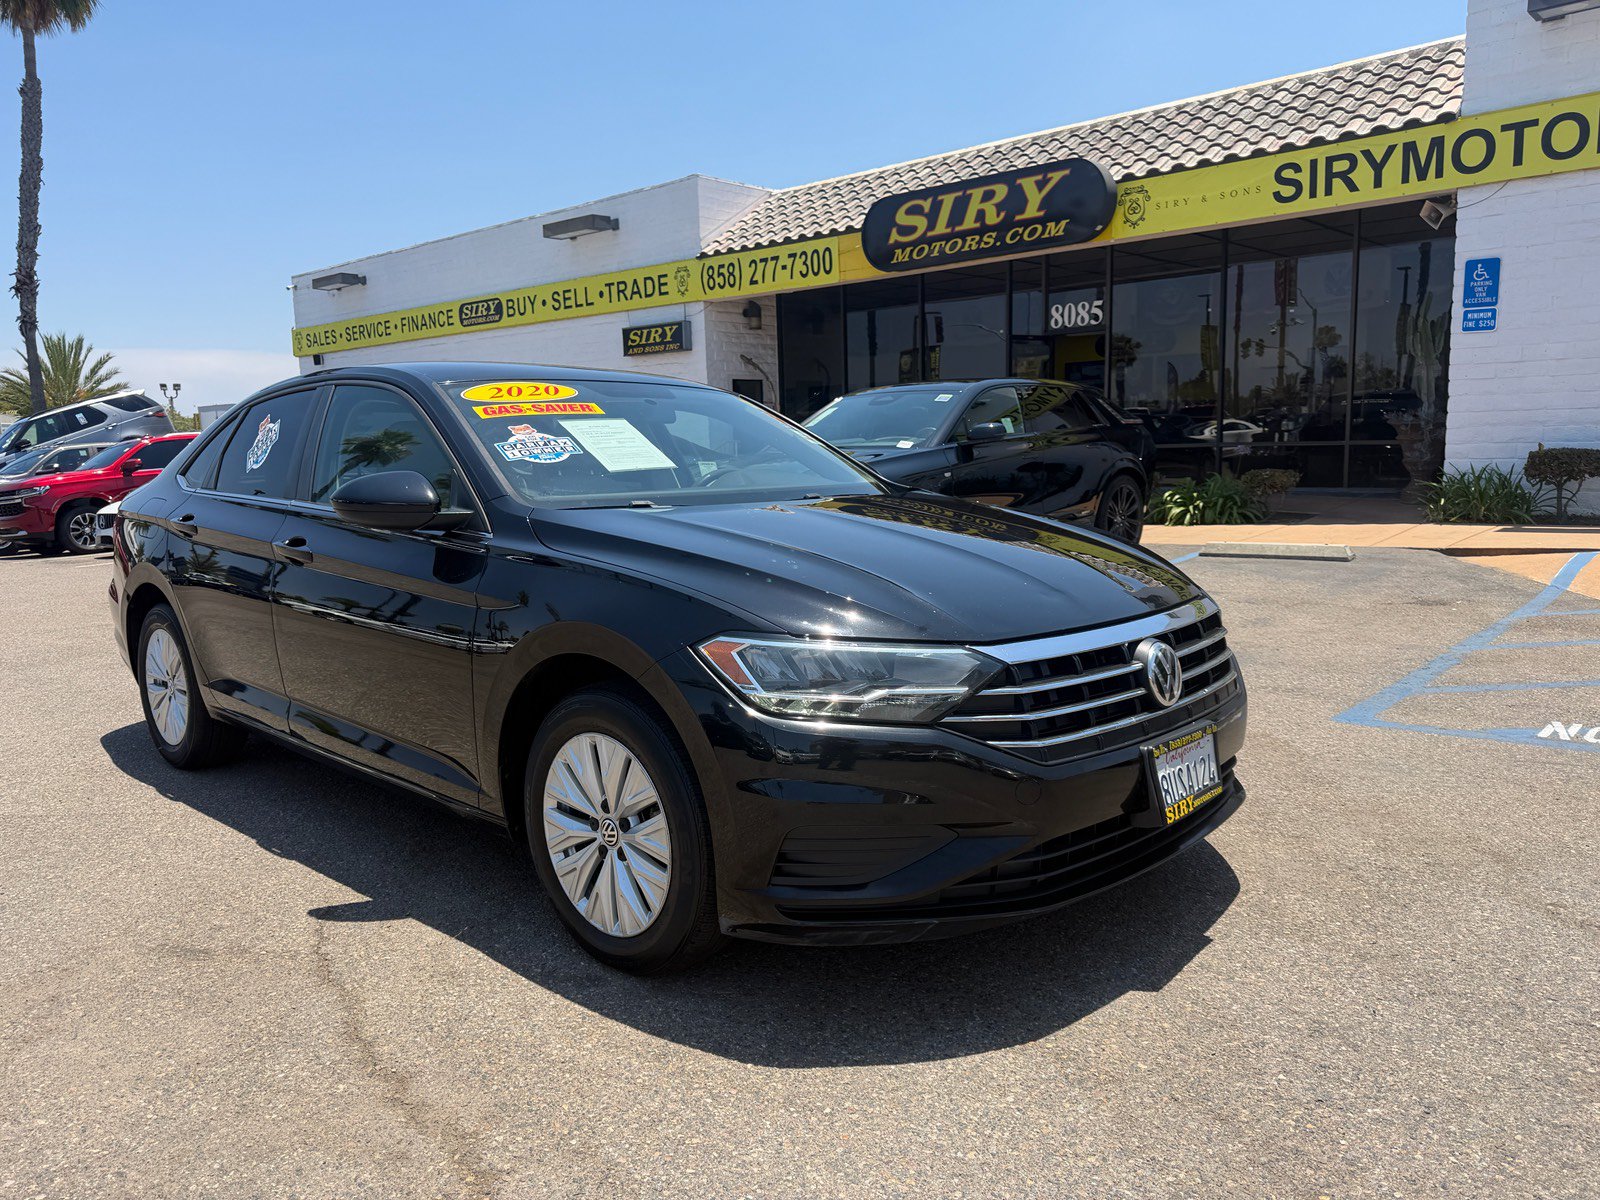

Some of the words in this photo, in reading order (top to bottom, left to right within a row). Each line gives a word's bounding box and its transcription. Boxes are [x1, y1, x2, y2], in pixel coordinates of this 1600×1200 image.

[1272, 107, 1600, 204] SIRYMOTO
[888, 168, 1072, 246] SIRY
[1155, 197, 1190, 211] SIRY
[1201, 195, 1208, 204] &
[1219, 185, 1262, 200] SONS
[891, 219, 1071, 264] MOTORS.COM
[700, 257, 743, 295] (858)
[749, 246, 834, 286] 277-7300
[506, 295, 538, 318] BUY
[552, 286, 595, 311] SELL
[605, 273, 670, 304] TRADE
[462, 300, 500, 319] SIRY
[1049, 300, 1104, 329] 8085
[1467, 312, 1492, 320] MINIMUM
[306, 329, 338, 349] SALES
[344, 320, 392, 342] SERVICE
[401, 309, 454, 334] FINANCE
[628, 325, 679, 346] SIRY
[1479, 320, 1495, 328] $250
[628, 347, 644, 355] AND
[644, 344, 665, 353] SONS
[666, 343, 680, 351] INC
[488, 385, 560, 399] 2020
[482, 403, 594, 416] GAS-SAVER
[502, 439, 571, 451] CARFAX
[519, 445, 577, 456] OWNER
[1160, 754, 1216, 805] 8USA124
[1166, 795, 1195, 824] SIRY
